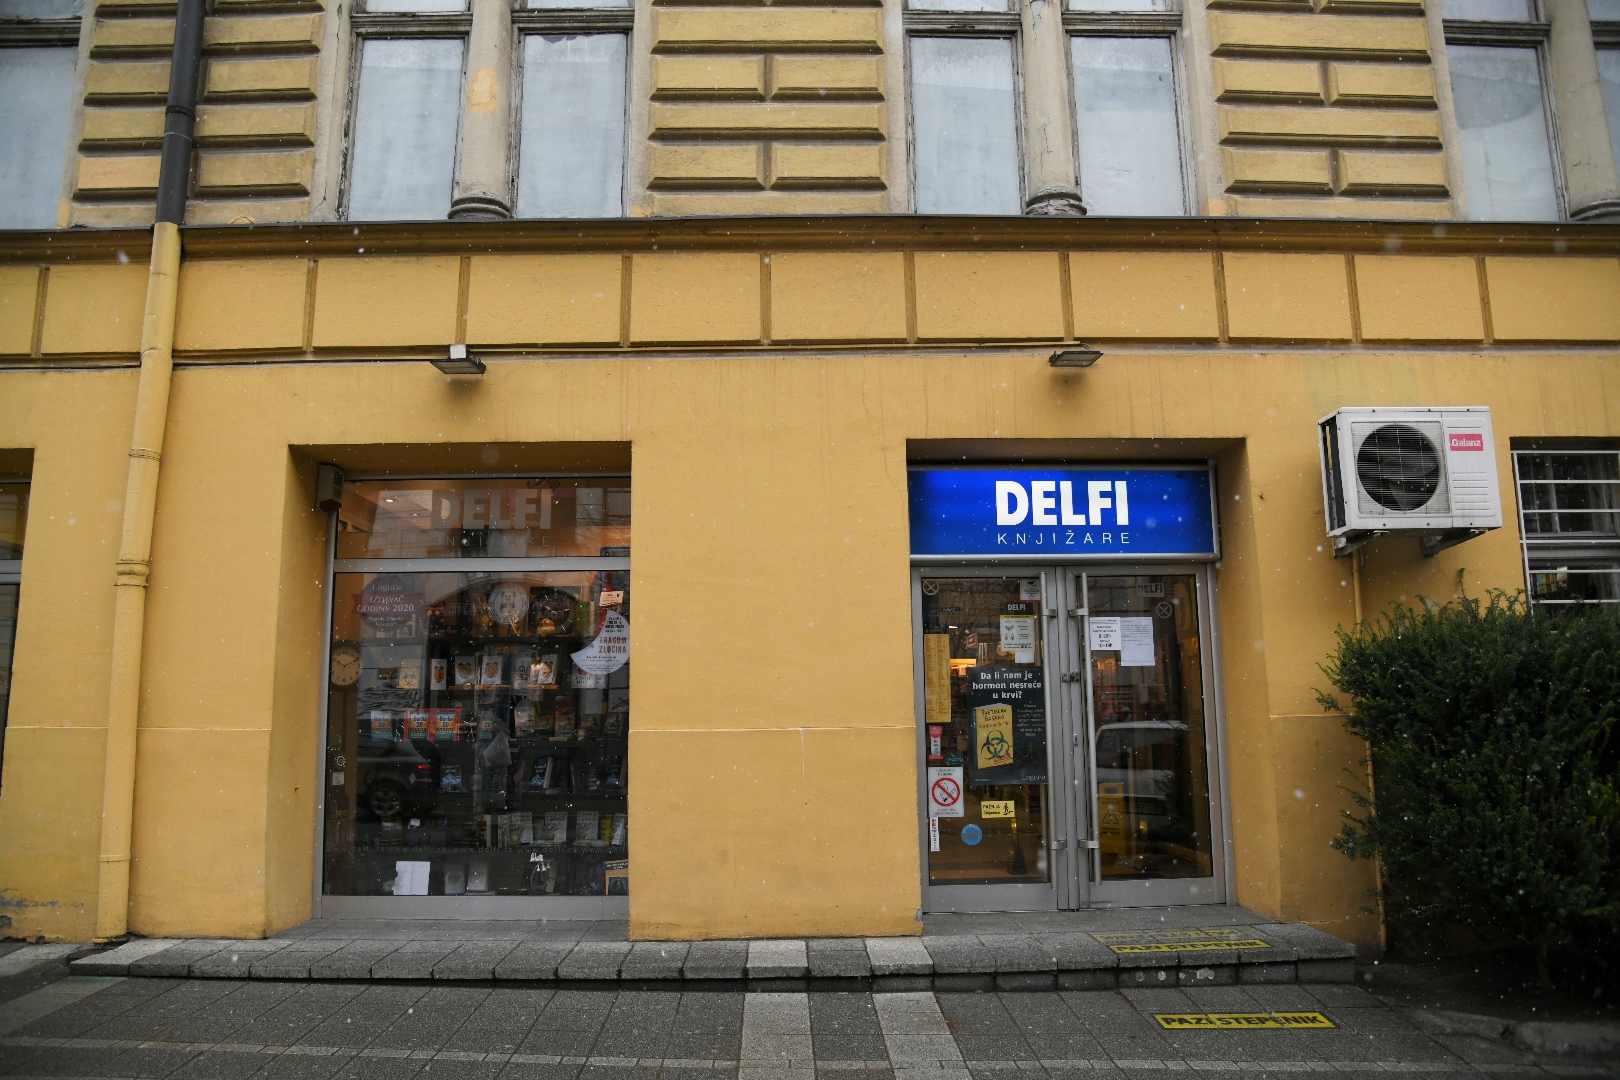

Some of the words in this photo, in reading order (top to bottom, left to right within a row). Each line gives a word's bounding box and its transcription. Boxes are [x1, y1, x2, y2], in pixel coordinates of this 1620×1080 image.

[1450, 438, 1481, 447] Galanz
[996, 480, 1129, 526] DELFI
[431, 488, 552, 529] DELFI
[997, 529, 1130, 545] KNJIŽARE
[372, 584, 403, 592] Laguna
[1137, 584, 1163, 594] DELFI
[369, 594, 405, 603] IZDAVAČ
[357, 604, 391, 613] GODINE
[392, 603, 416, 612] 2020.
[1007, 603, 1026, 611] DELFI
[599, 636, 627, 644] TRAGOM
[980, 672, 991, 680] Da
[994, 671, 1000, 679] li
[1024, 671, 1033, 680] je
[972, 682, 1006, 690] hormon
[1001, 691, 1022, 699] krvi?
[1160, 1017, 1214, 1026] PAZI
[1215, 1015, 1325, 1026] STEPENIK
